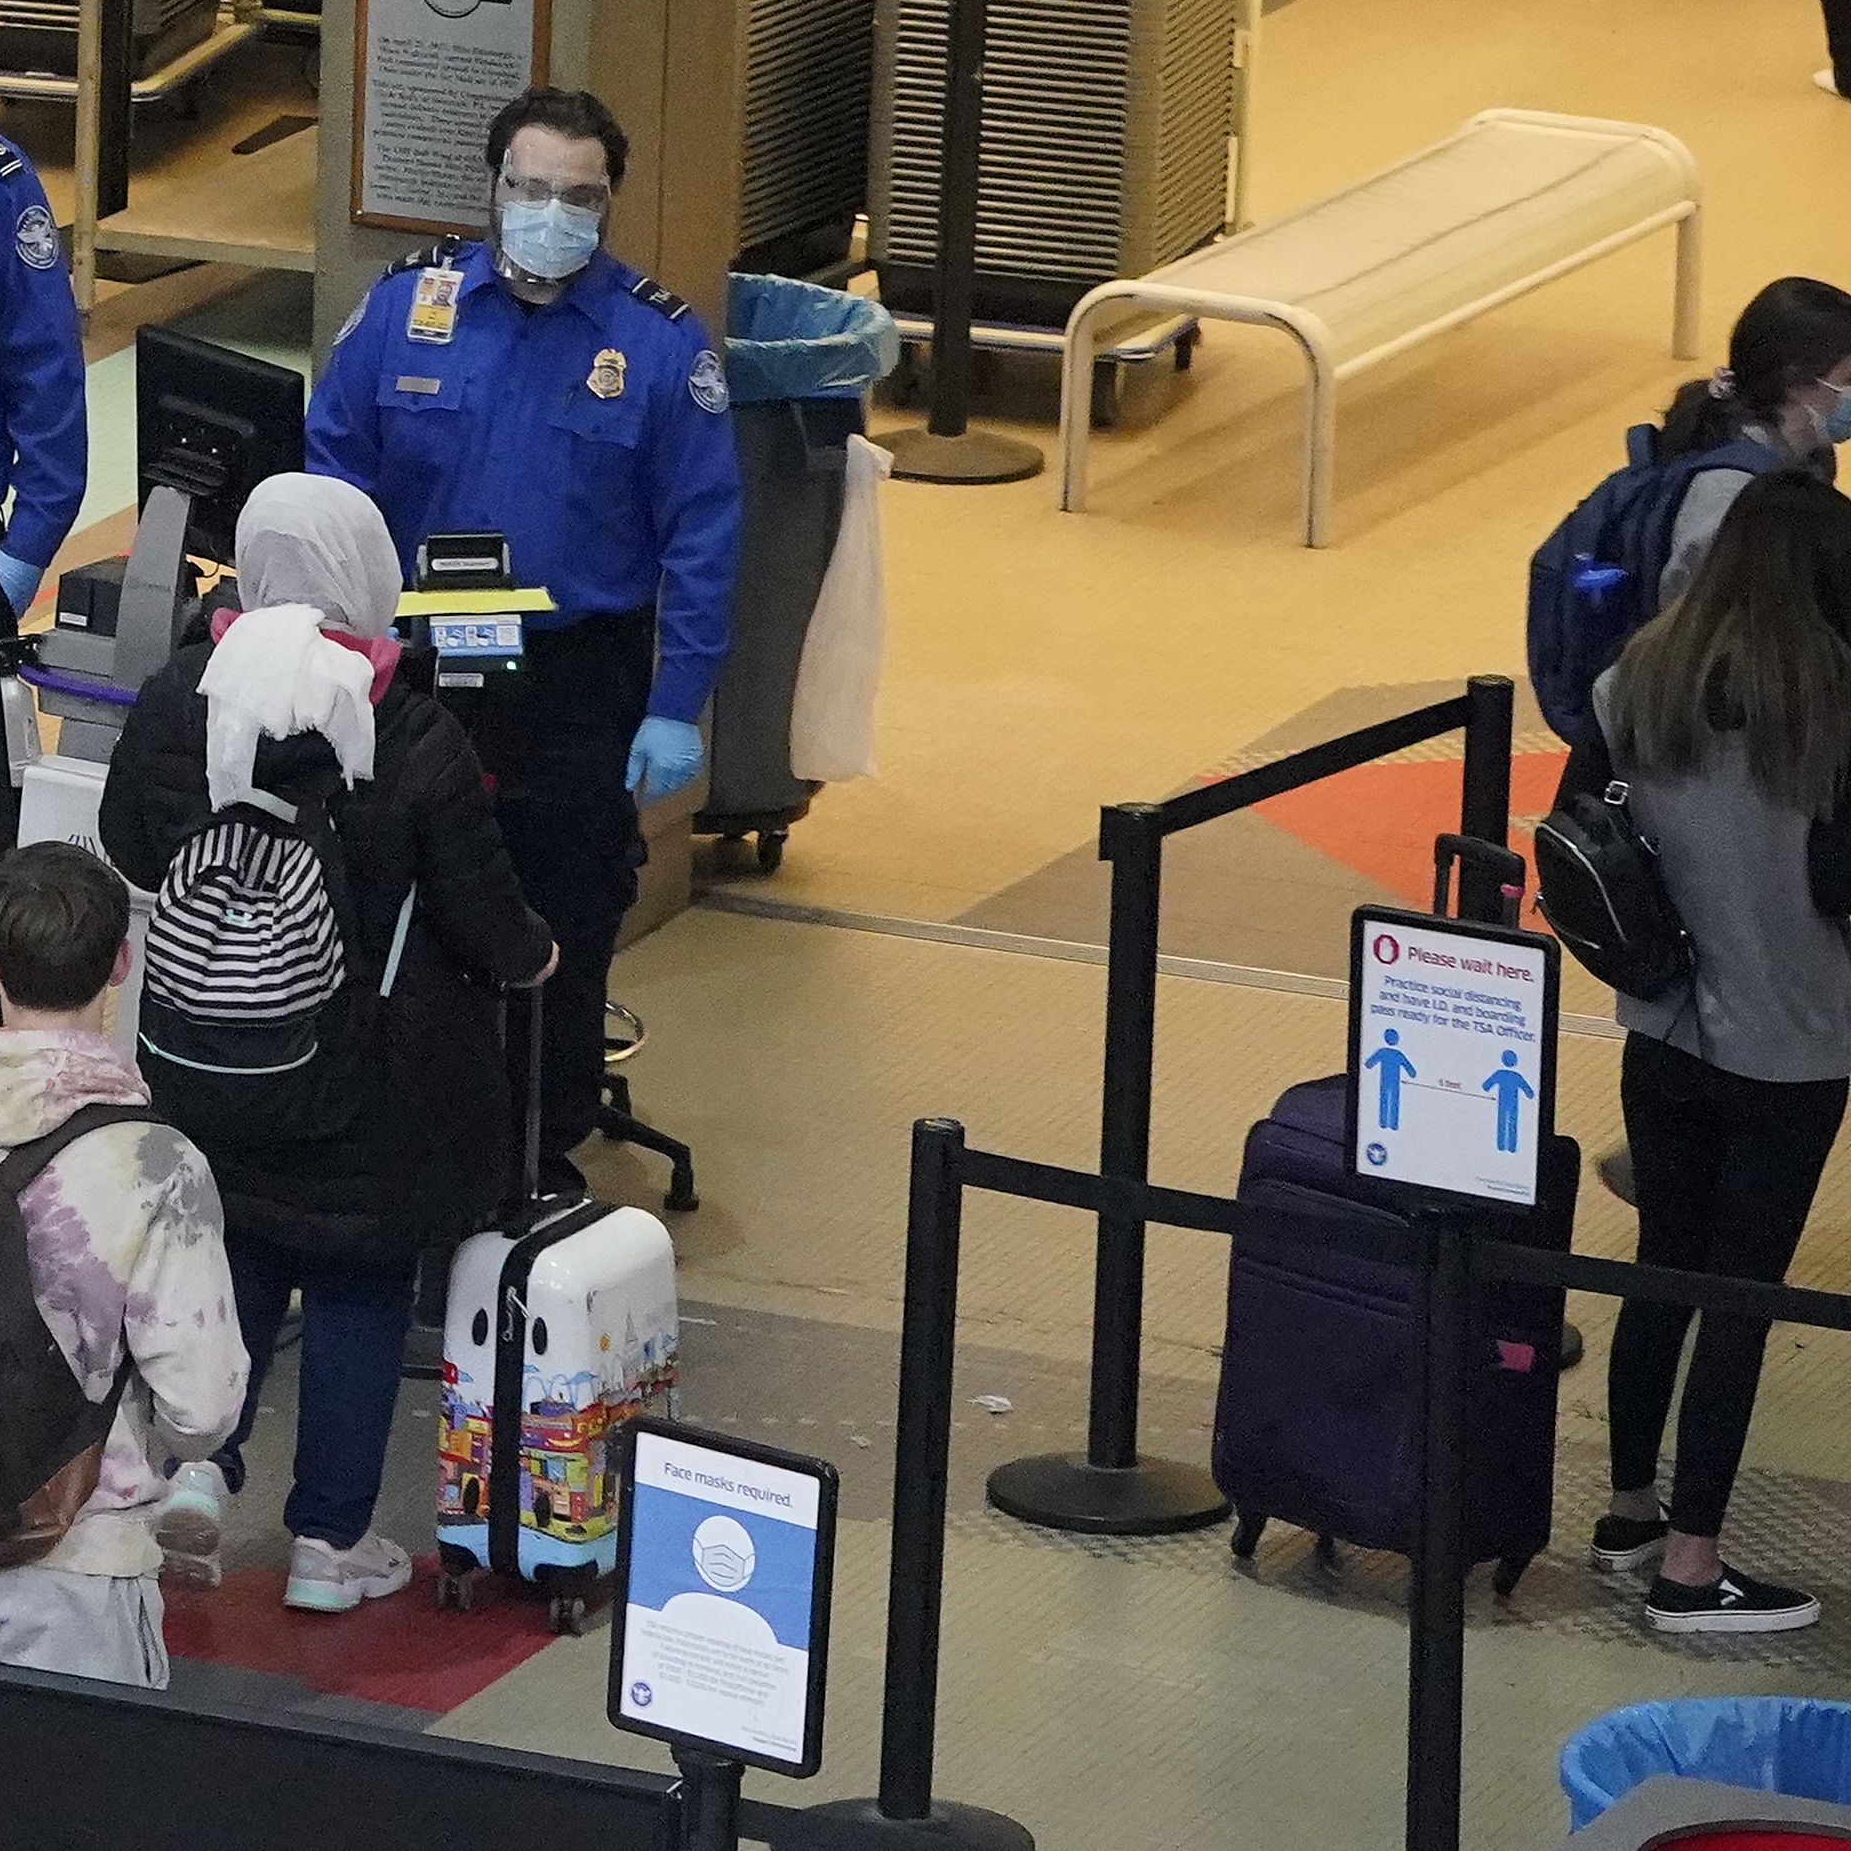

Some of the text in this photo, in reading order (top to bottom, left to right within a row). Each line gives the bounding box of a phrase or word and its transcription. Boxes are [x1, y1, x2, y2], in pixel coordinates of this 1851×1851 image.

[1408, 945, 1534, 982] Please wait here.
[664, 1461, 793, 1508] Face masks required.
